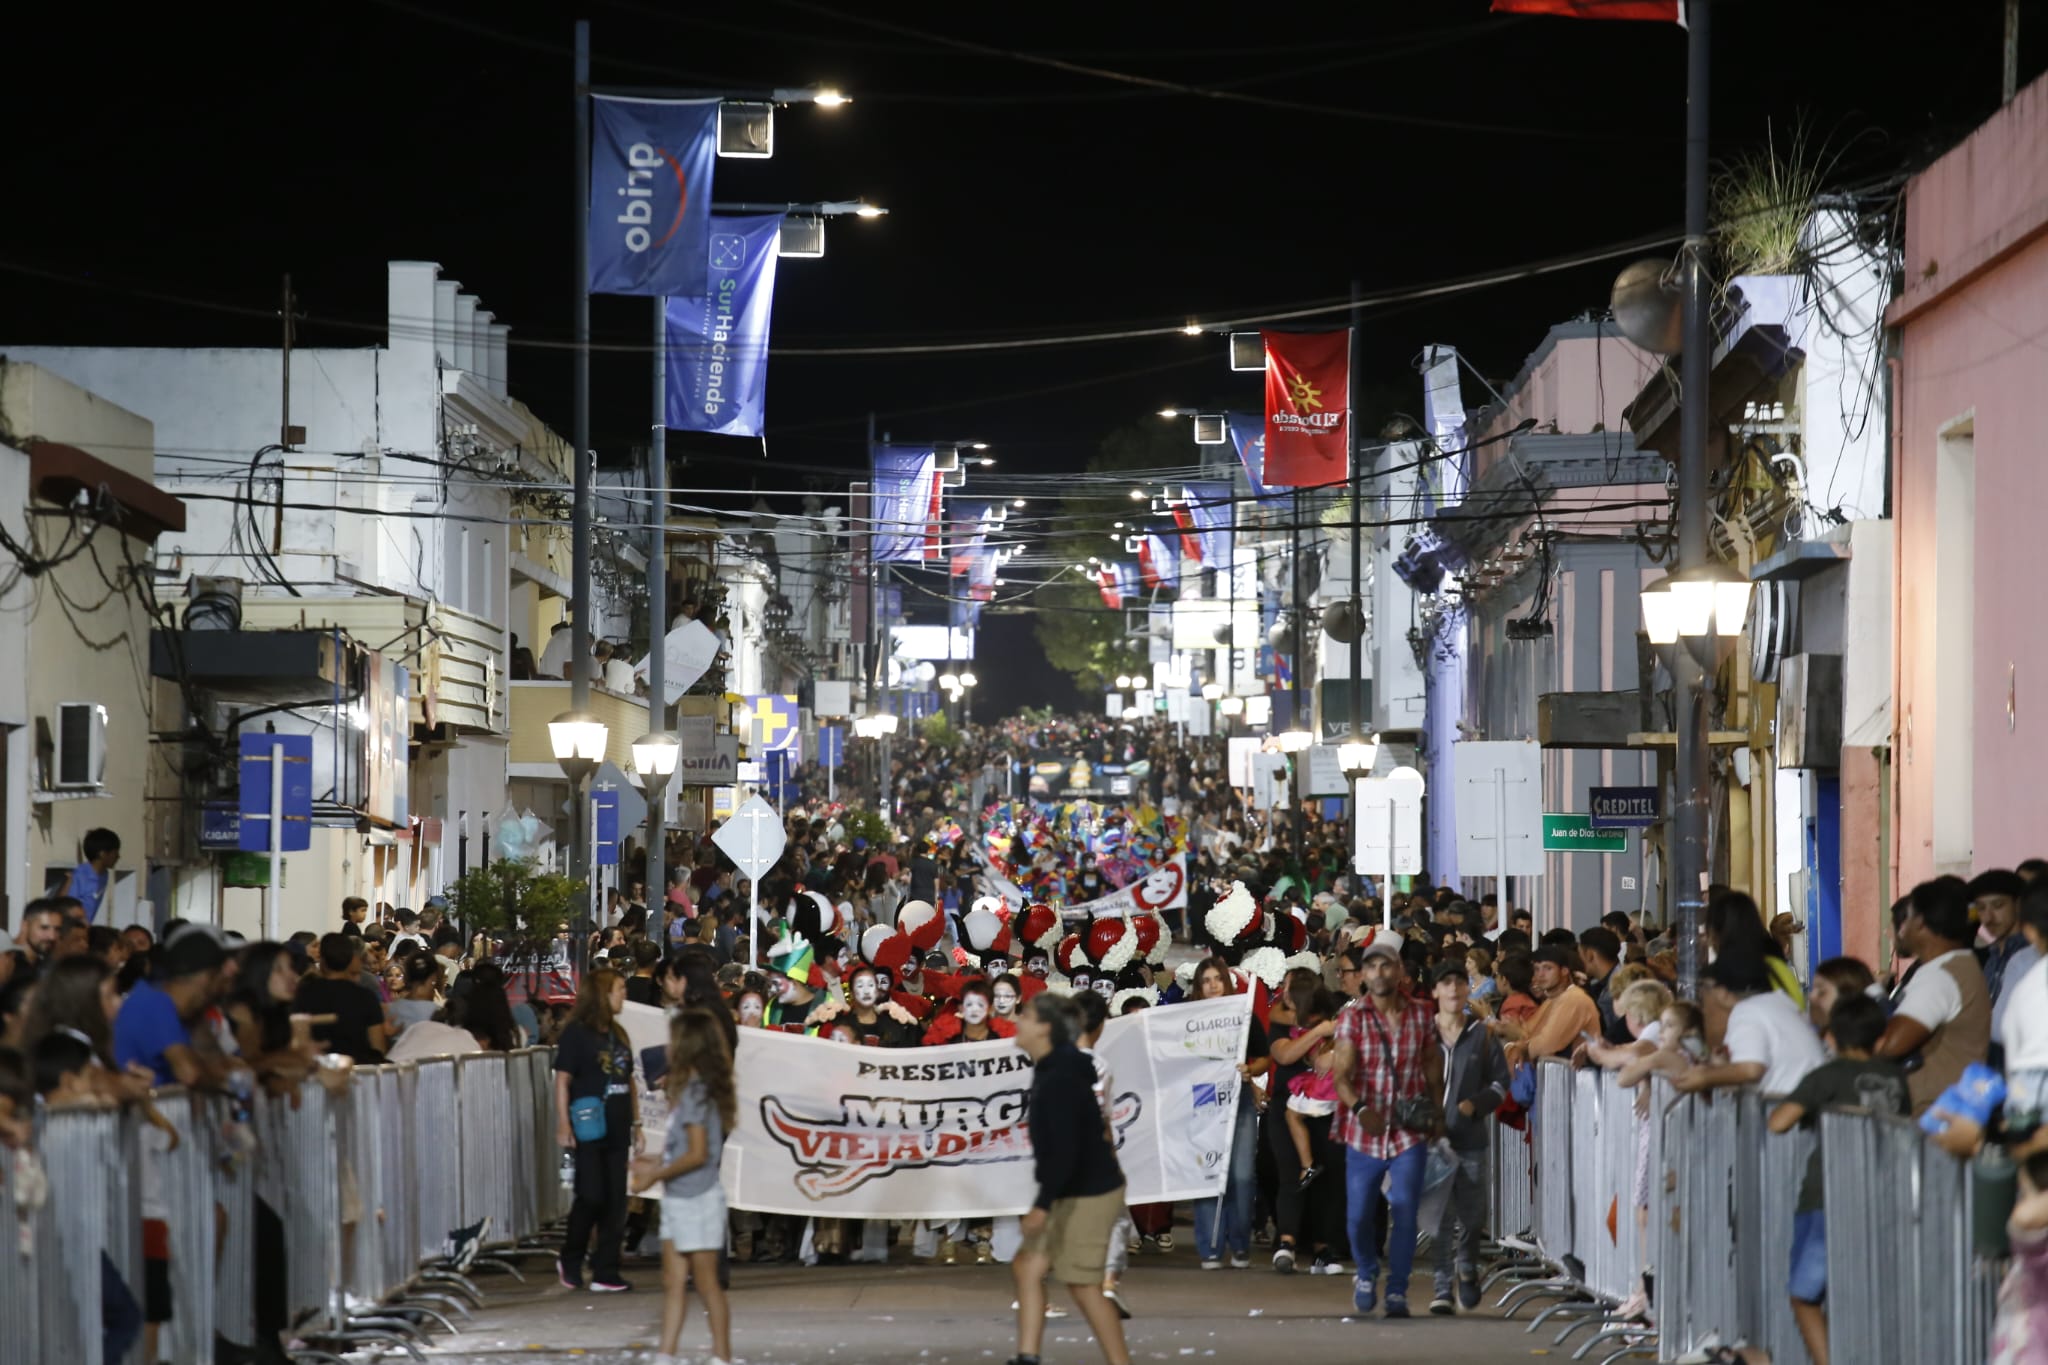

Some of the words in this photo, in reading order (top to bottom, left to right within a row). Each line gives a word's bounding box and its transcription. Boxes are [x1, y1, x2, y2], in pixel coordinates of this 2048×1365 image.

[704, 278, 737, 415] SurHacienda
[1593, 795, 1655, 816] CREDITEL
[205, 831, 240, 841] CIGARR
[1551, 828, 1567, 837] Juan
[1568, 828, 1578, 837] de
[1579, 828, 1595, 838] Dios
[1186, 1016, 1243, 1033] CHARRU
[857, 1054, 1034, 1081] PRESENTAN
[844, 1094, 1024, 1131] MURG
[797, 1130, 924, 1162] VIEJA
